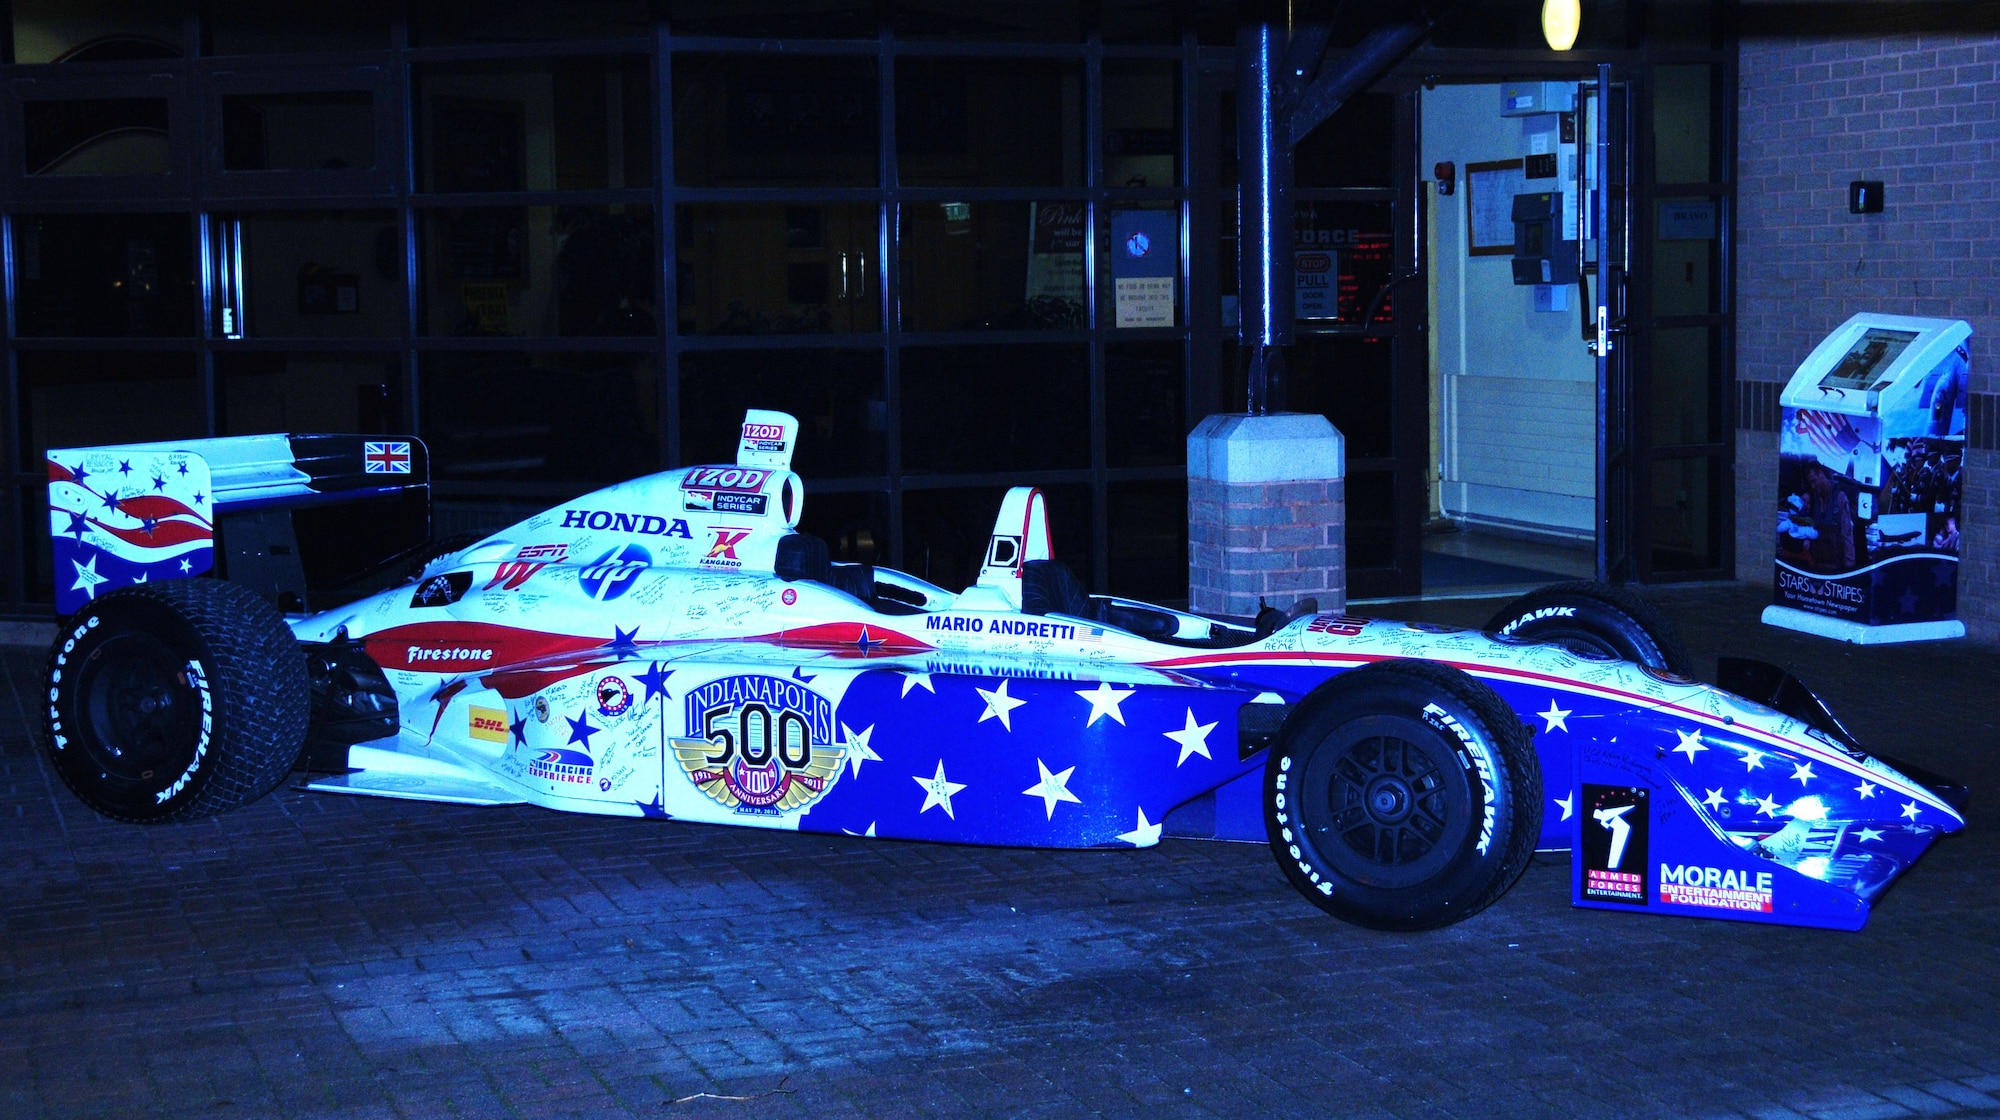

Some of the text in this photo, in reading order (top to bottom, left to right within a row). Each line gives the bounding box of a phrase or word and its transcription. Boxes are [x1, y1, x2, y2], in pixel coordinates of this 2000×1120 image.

[1302, 260, 1326, 268] STOP
[1297, 275, 1329, 286] PULL
[744, 424, 780, 438] IZOD
[685, 468, 764, 488] IZOD
[716, 502, 752, 511] SERIES
[717, 495, 760, 504] INDYCAR
[560, 510, 694, 540] HONDA
[516, 543, 568, 558] ESPN
[580, 544, 649, 601] hp
[700, 558, 742, 568] KANGAROO
[1779, 571, 1810, 592] STARS
[1784, 590, 1858, 613] Your Hometown Newspaper
[1824, 580, 1863, 604] STRIPES
[926, 616, 1075, 640] MARIO ANDRETTI
[1502, 606, 1576, 634] HAWK
[407, 646, 493, 664] Firestone
[50, 616, 100, 750] Firestone
[687, 676, 830, 744] INDIANAPOLIS
[156, 660, 213, 805] FIREHAWK
[473, 718, 505, 732] DHL
[703, 701, 812, 771] 500
[529, 767, 592, 784] EXPERIENCE
[554, 764, 593, 776] RACING
[694, 772, 712, 782] 1911
[1422, 702, 1496, 857] FIREHAWK
[804, 777, 821, 790] 2011
[730, 784, 785, 805] ANNIVERSARY
[1276, 756, 1336, 896] Firestone
[1590, 870, 1640, 882] ARMED
[1660, 862, 1773, 894] MORALE
[1590, 880, 1640, 892] FORCES
[1660, 884, 1772, 903] ENTERTAINMENT
[1670, 894, 1762, 911] FOUNDATION
